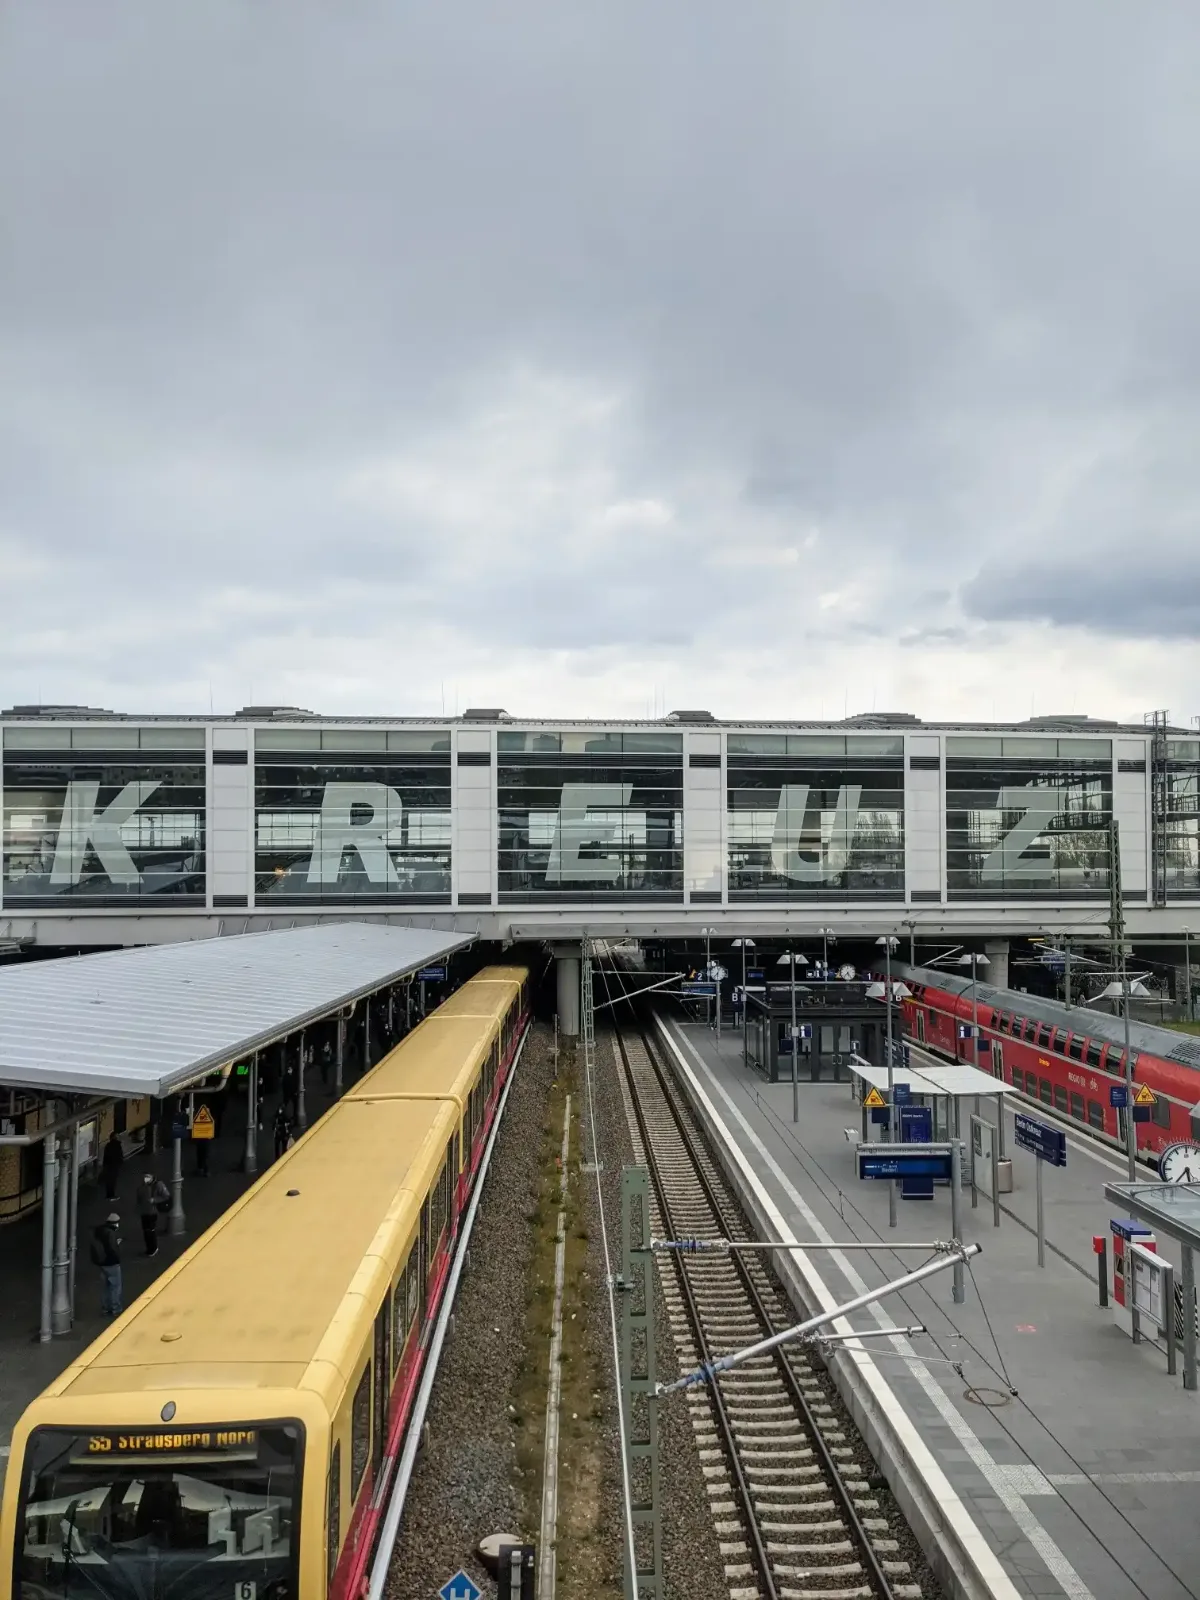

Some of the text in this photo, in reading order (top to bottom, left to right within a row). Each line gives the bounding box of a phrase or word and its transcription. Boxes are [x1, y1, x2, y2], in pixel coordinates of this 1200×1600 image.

[49, 780, 1067, 884] KREUZ
[697, 972, 703, 980] 2
[732, 992, 738, 1002] B
[89, 1435, 112, 1451] S5
[241, 1580, 251, 1600] 6
